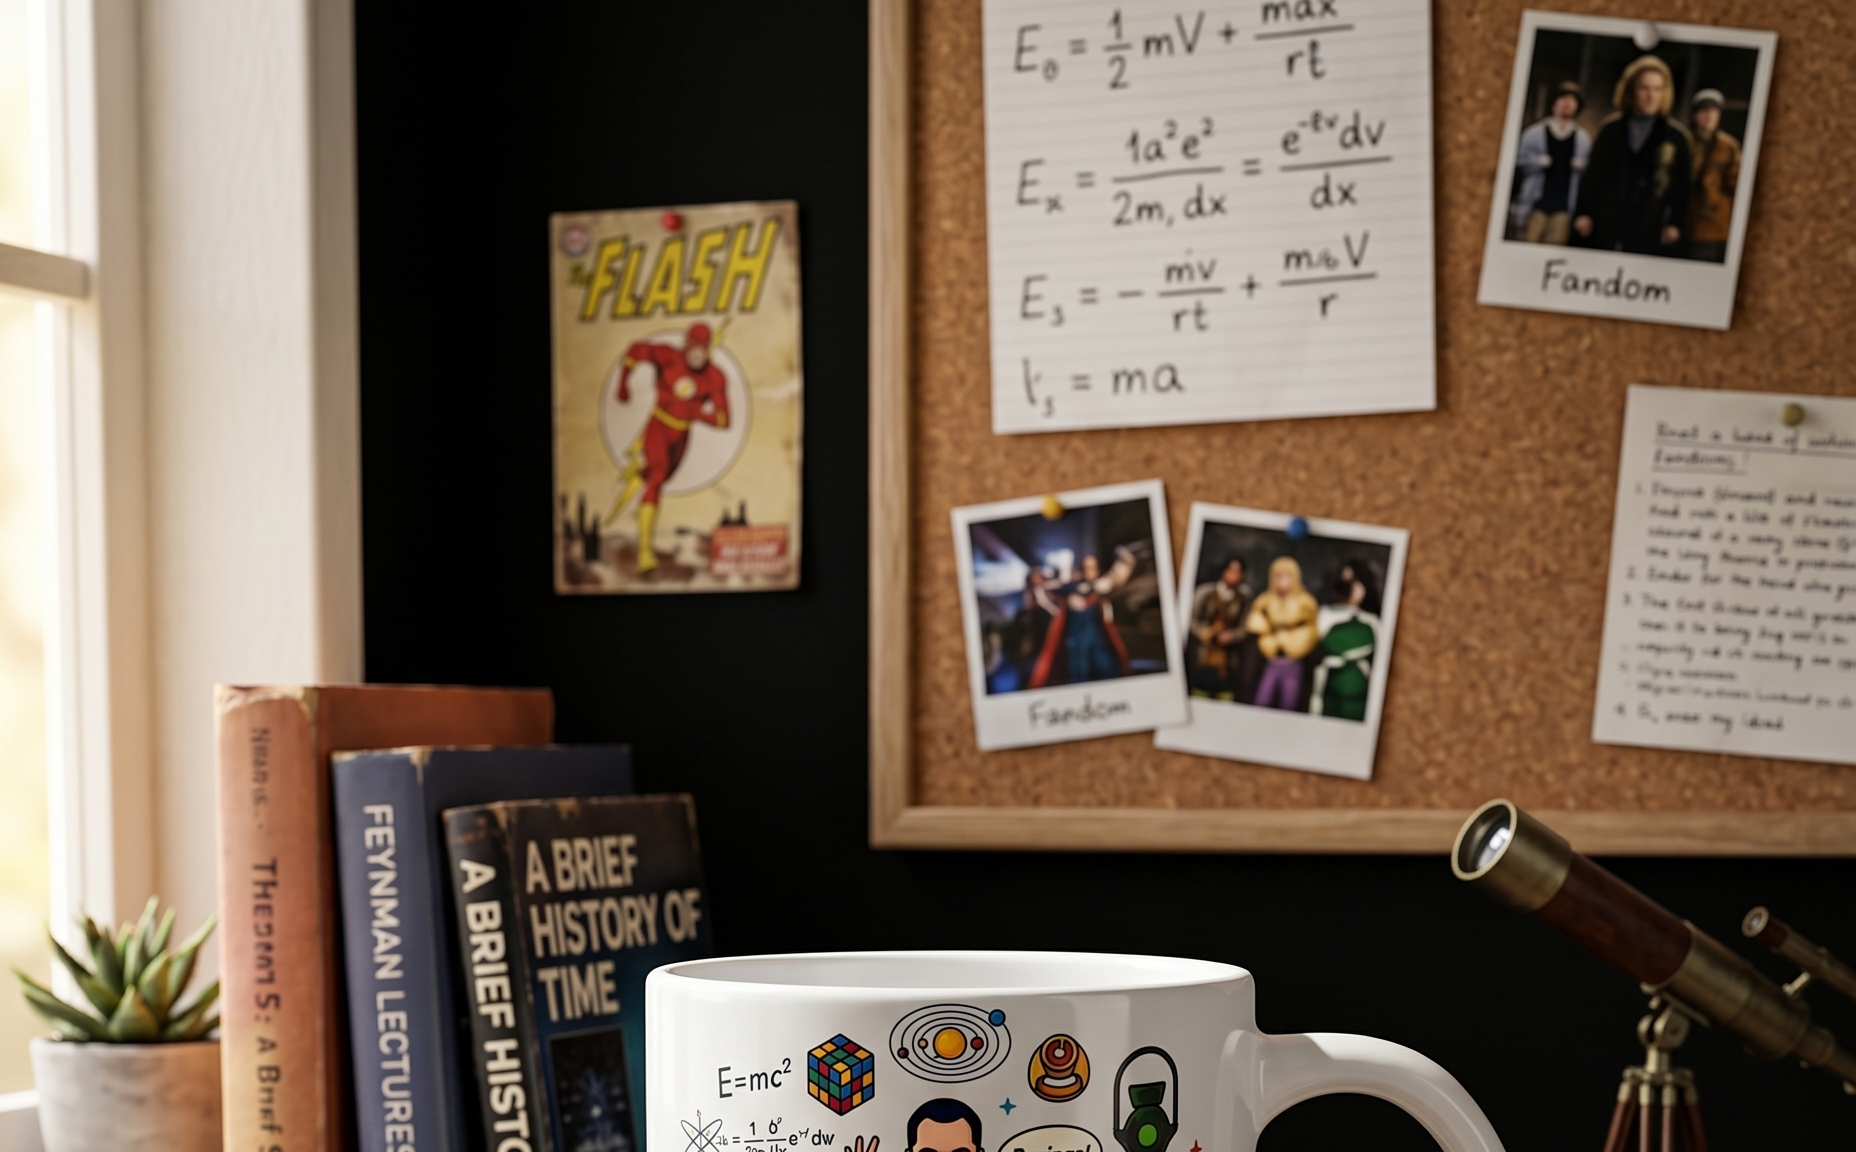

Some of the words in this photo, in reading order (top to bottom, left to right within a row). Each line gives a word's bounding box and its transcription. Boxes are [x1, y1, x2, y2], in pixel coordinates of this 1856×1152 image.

[578, 217, 780, 322] FLASH
[1542, 259, 1671, 303] Fandom
[1027, 697, 1132, 731] Fandom
[362, 804, 405, 981] FEYNMAN
[459, 859, 497, 894] A
[526, 839, 550, 895] A
[552, 833, 638, 892] BRIEF
[529, 892, 659, 959] HISTORY
[664, 886, 702, 944] OF
[465, 900, 516, 1029] BRIEF
[537, 958, 621, 1023] TIME
